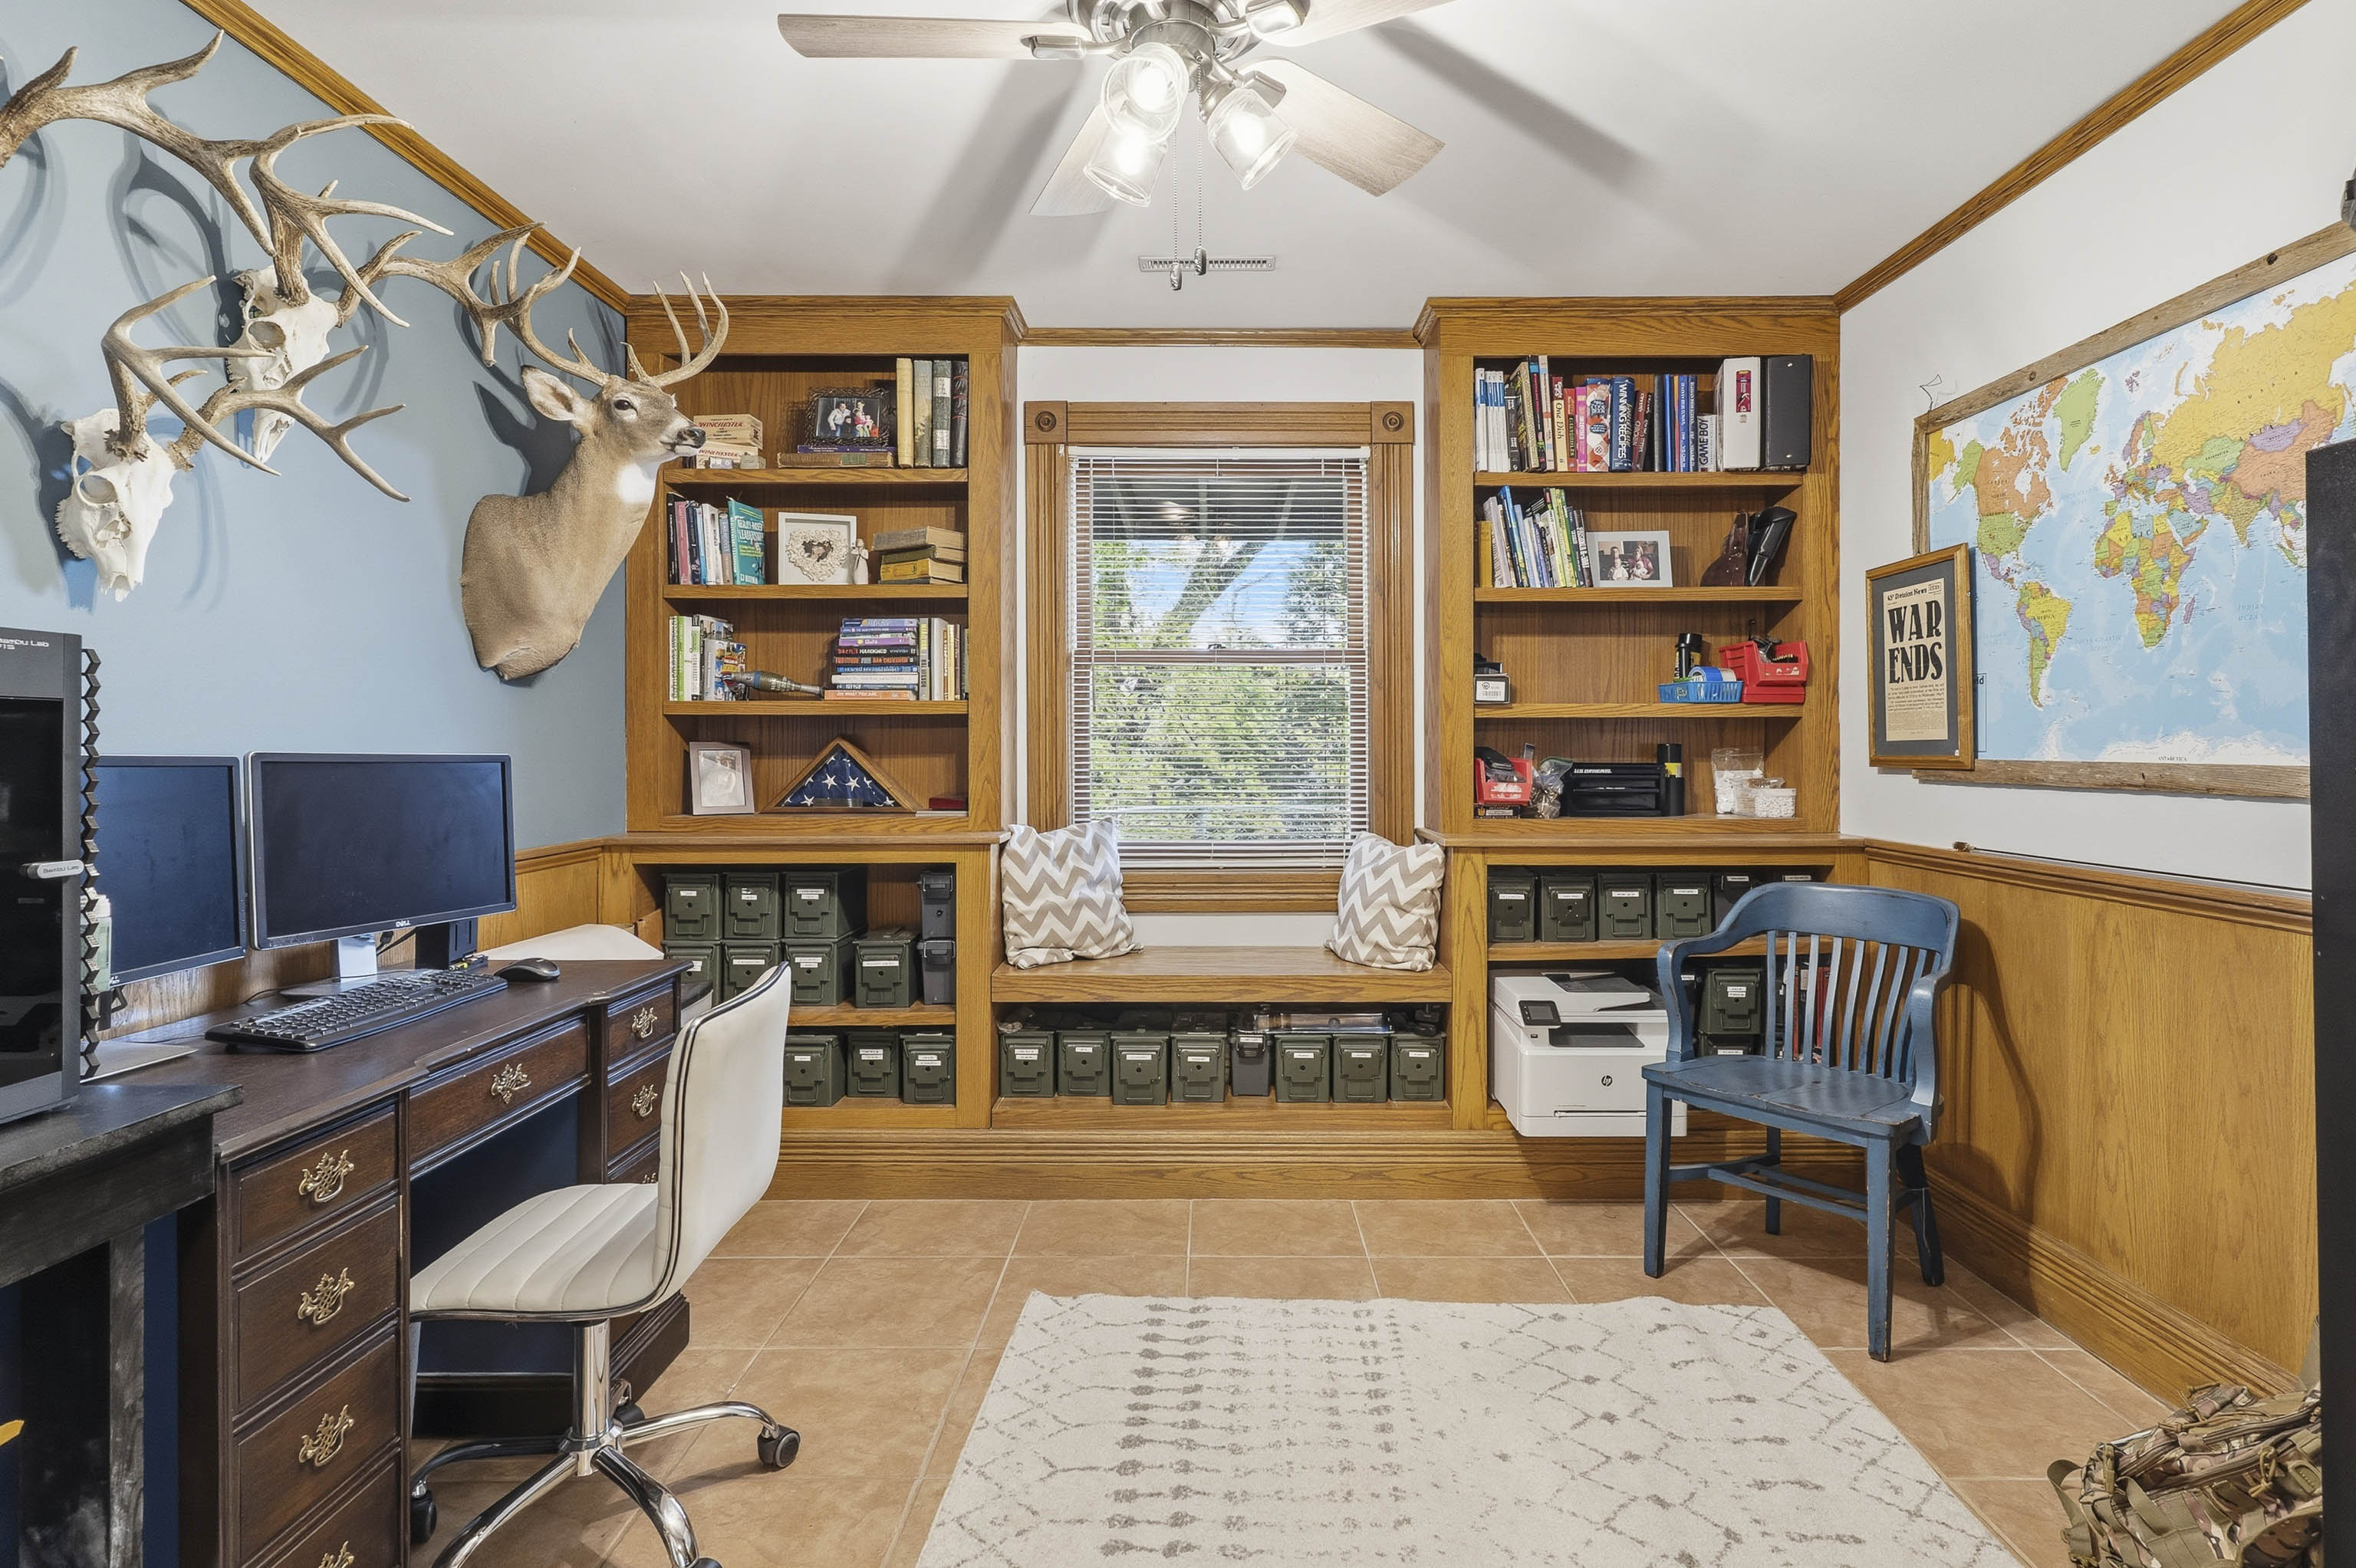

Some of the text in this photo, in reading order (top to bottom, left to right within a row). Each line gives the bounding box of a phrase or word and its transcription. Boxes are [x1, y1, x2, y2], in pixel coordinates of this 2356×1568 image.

[1555, 403, 1564, 419] One
[1619, 383, 1627, 422] WINNING
[1556, 421, 1565, 439] Dish
[1617, 423, 1627, 459] RECIPES
[1698, 418, 1709, 465] GAME BOY
[699, 449, 738, 458] WINCHESTER
[1887, 600, 1942, 644] WAR
[1888, 642, 1943, 684] ENDS
[395, 919, 411, 928] DELL
